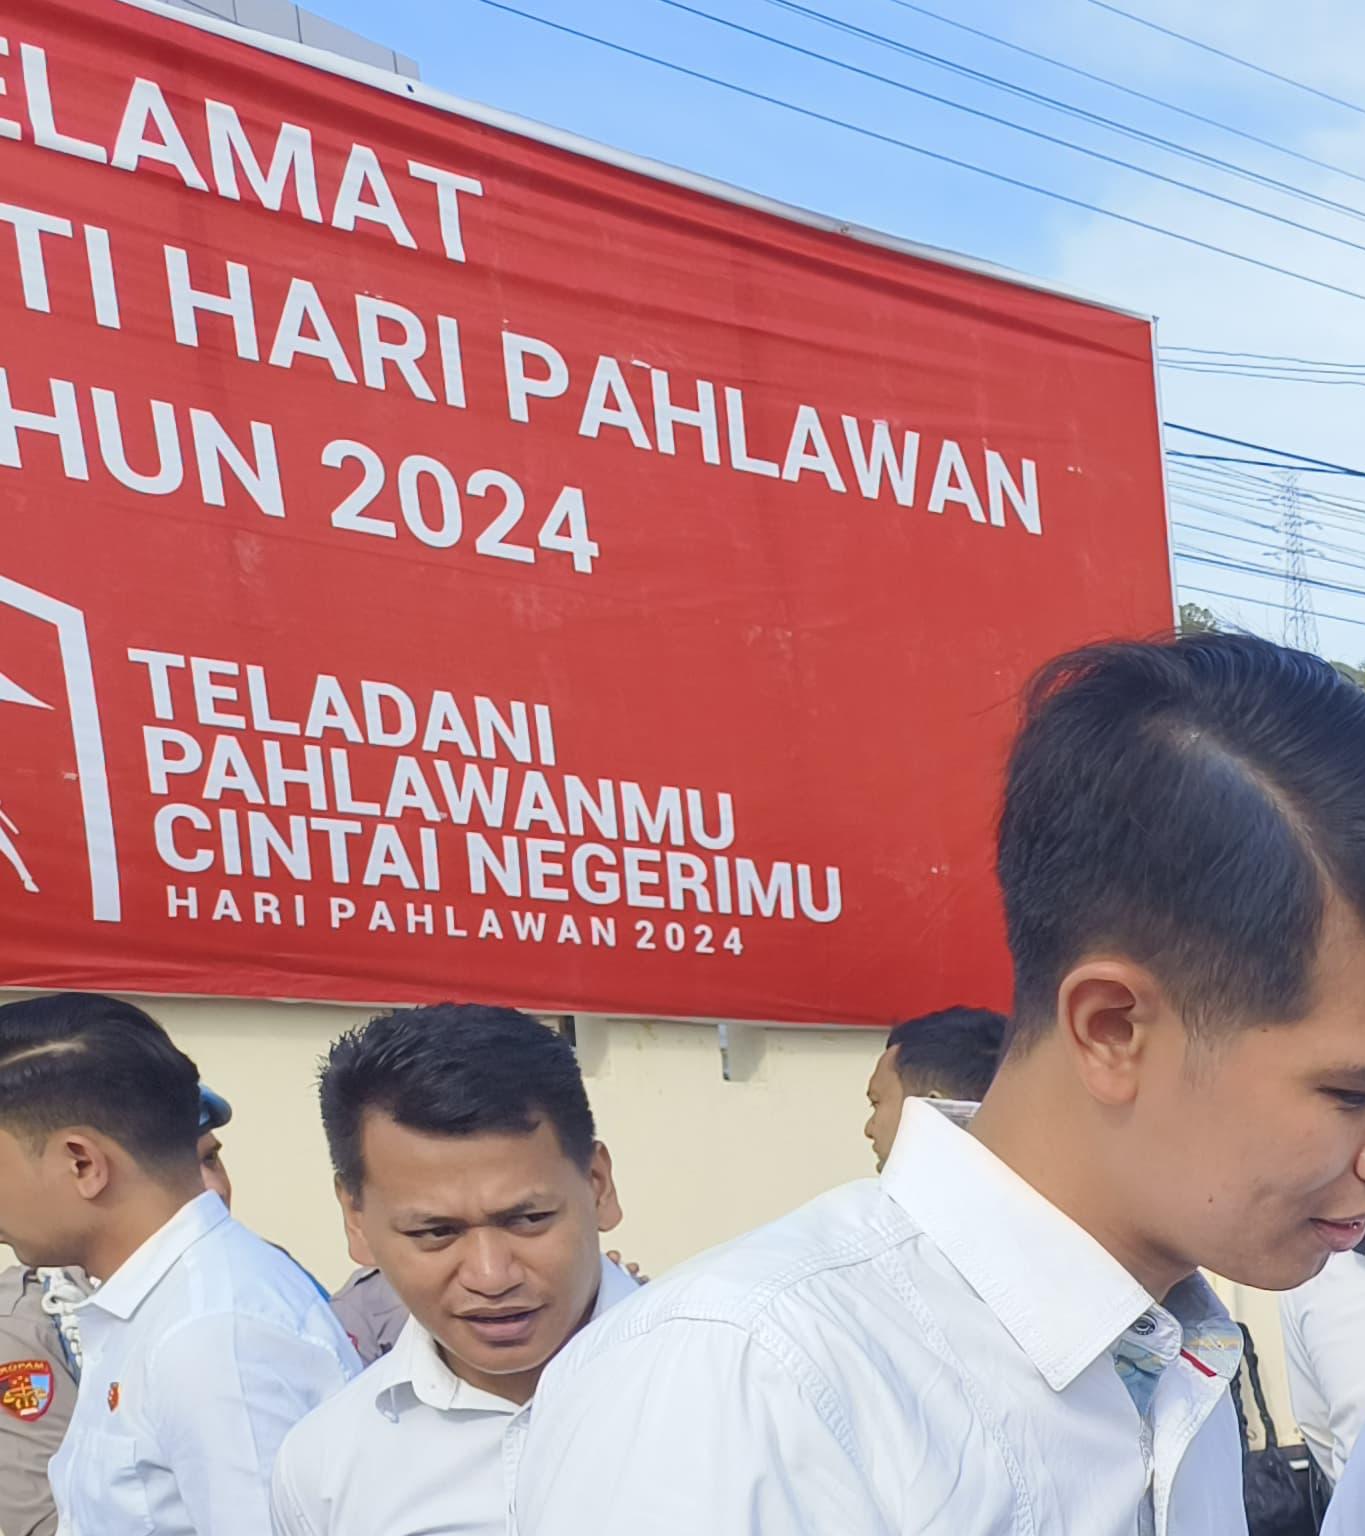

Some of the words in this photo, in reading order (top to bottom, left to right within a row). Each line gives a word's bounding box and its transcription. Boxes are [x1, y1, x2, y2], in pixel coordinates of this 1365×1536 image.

[163, 244, 466, 409] HARI
[501, 330, 1043, 536] PAHLAWAN
[320, 438, 600, 574] 2024
[127, 647, 557, 766] TELADANI
[142, 725, 736, 851] PAHLAWANMU
[153, 802, 441, 892] CINTAI
[465, 831, 843, 923] NEGERIMU
[166, 884, 306, 927] HARI
[329, 896, 617, 948] PAHLAWAN
[634, 919, 744, 956] 2024
